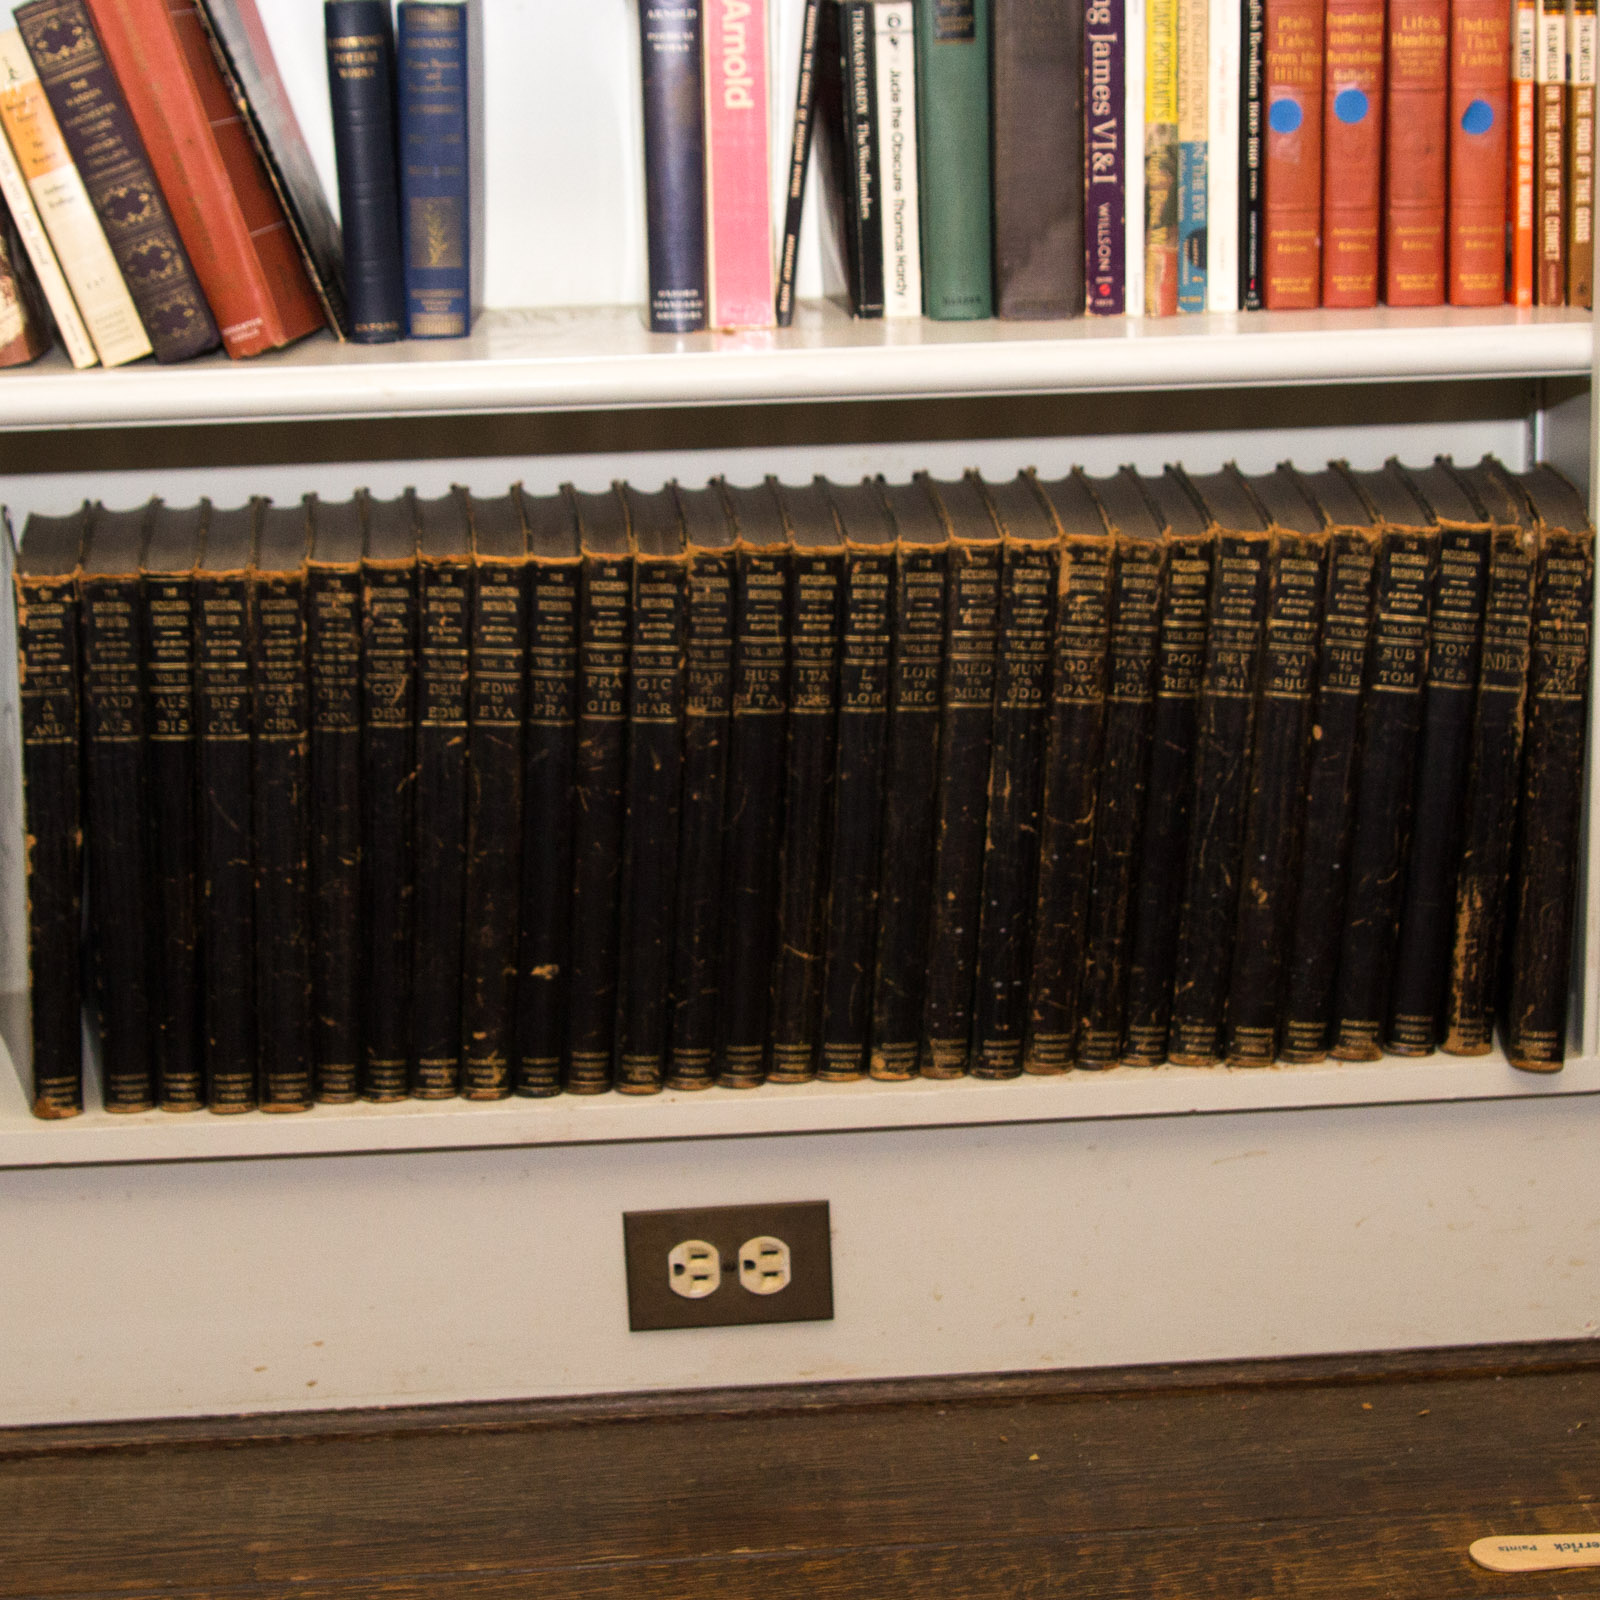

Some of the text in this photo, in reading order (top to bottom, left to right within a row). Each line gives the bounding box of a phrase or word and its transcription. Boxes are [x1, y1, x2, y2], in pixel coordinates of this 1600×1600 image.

[647, 8, 697, 20] ARNOLD
[1401, 15, 1440, 30] Life's
[851, 10, 866, 65] THOMAS
[1275, 32, 1315, 48] Tales
[1466, 34, 1498, 49] That
[1191, 15, 1206, 81] ENGLISH
[722, 0, 755, 110] Arnold
[1460, 52, 1502, 67] Failed
[1249, 32, 1263, 98] Revolution
[1088, 32, 1118, 116] James
[1152, 41, 1171, 119] PORTRAITS
[1274, 67, 1313, 81] Hills
[854, 66, 868, 114] HARDY
[889, 68, 902, 103] Jude
[1191, 82, 1206, 130] PEOPLE
[891, 106, 902, 128] the
[857, 122, 870, 144] The
[1091, 117, 1118, 184] VI&I
[1575, 88, 1591, 244] THE FOOD OF THE GODS
[1191, 162, 1206, 192] THE
[1544, 86, 1560, 261] IN THE DAYS OF THE COMET
[1191, 195, 1206, 221] EVE
[893, 199, 906, 251] Thomas
[1097, 201, 1111, 272] WILLSON
[894, 255, 908, 296] Hardy
[1277, 654, 1307, 667] SAI
[1331, 648, 1364, 662] SHU
[1382, 647, 1416, 661] SUB
[956, 663, 991, 675] MED
[1009, 663, 1044, 676] MUN
[1115, 658, 1150, 671] PAY
[744, 669, 780, 682] HUS
[799, 670, 830, 682] ITA
[902, 666, 937, 679] LOR
[1329, 672, 1360, 686] SUB
[1381, 671, 1415, 684] TOM
[535, 681, 567, 693] EVA
[588, 675, 622, 688] FRA
[636, 678, 671, 690] GIC
[1114, 682, 1149, 694] POL
[1216, 676, 1245, 689] SAI
[1273, 677, 1307, 690] SHU
[480, 682, 516, 695] EDW
[954, 688, 991, 699] MUM
[1063, 683, 1097, 696] PAY
[99, 695, 133, 708] AND
[155, 695, 188, 709] AUS
[211, 696, 240, 709] BIS
[847, 693, 882, 705] LOR
[900, 690, 936, 703] MEC
[480, 706, 515, 719] EVA
[534, 704, 568, 716] FRA
[587, 701, 621, 712] GIB
[637, 703, 672, 715] HAR
[157, 720, 189, 732] BIS
[209, 721, 241, 733] CAL
[1554, 1541, 1600, 1553] errick
